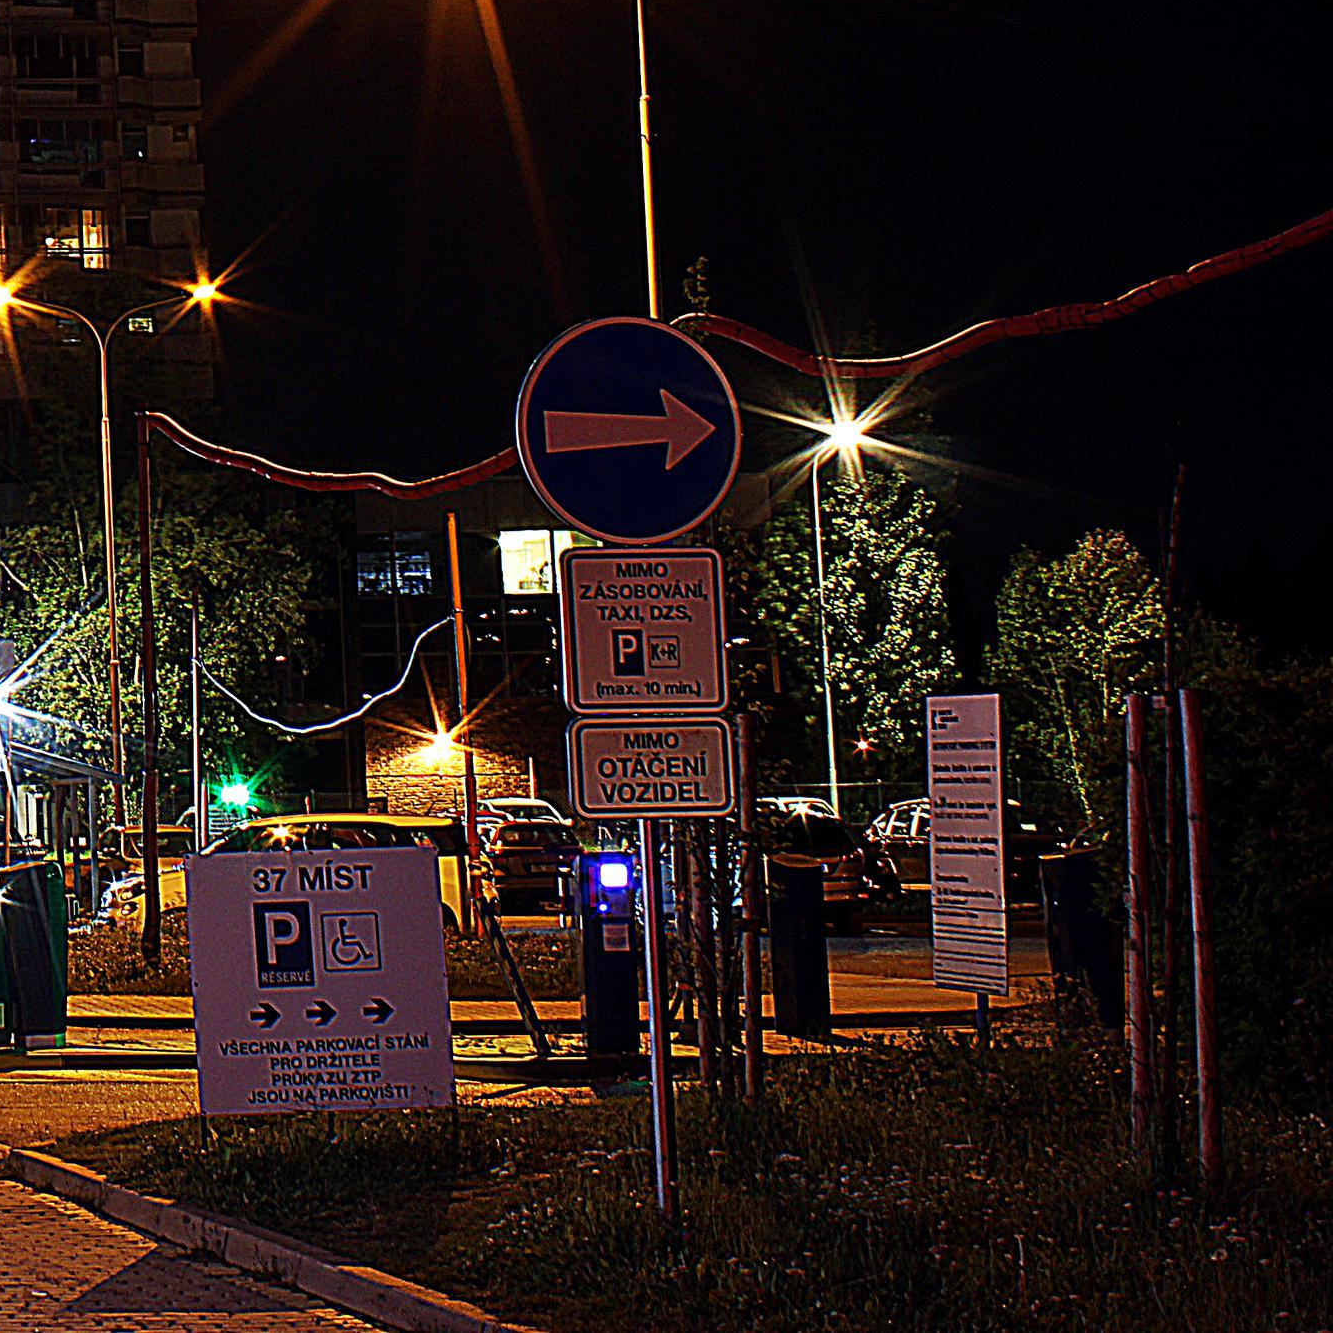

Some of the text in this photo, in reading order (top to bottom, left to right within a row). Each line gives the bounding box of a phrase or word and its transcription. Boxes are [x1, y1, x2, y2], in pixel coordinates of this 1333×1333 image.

[616, 563, 669, 578] MIMO
[579, 580, 708, 601] ZÁSOBOVÁNÍ,
[597, 605, 692, 623] TAXI, DZS,
[618, 634, 677, 664] P K+R
[596, 680, 702, 698] (max. 10 min.)
[623, 732, 680, 750] MIMO
[597, 750, 708, 778] OTÁČENÍ
[599, 781, 710, 803] VOZIDEL
[253, 858, 374, 893] 37 MÍST
[265, 911, 300, 965] P
[218, 1032, 430, 1056] VŠECHNA PARKOVACÍ STÁNÍ
[270, 1051, 381, 1071] PRO DRŽITELE
[271, 1068, 382, 1087] PRŮKAZU ZTP
[248, 1082, 410, 1105] JSOU NA PARKOVIŠTI
